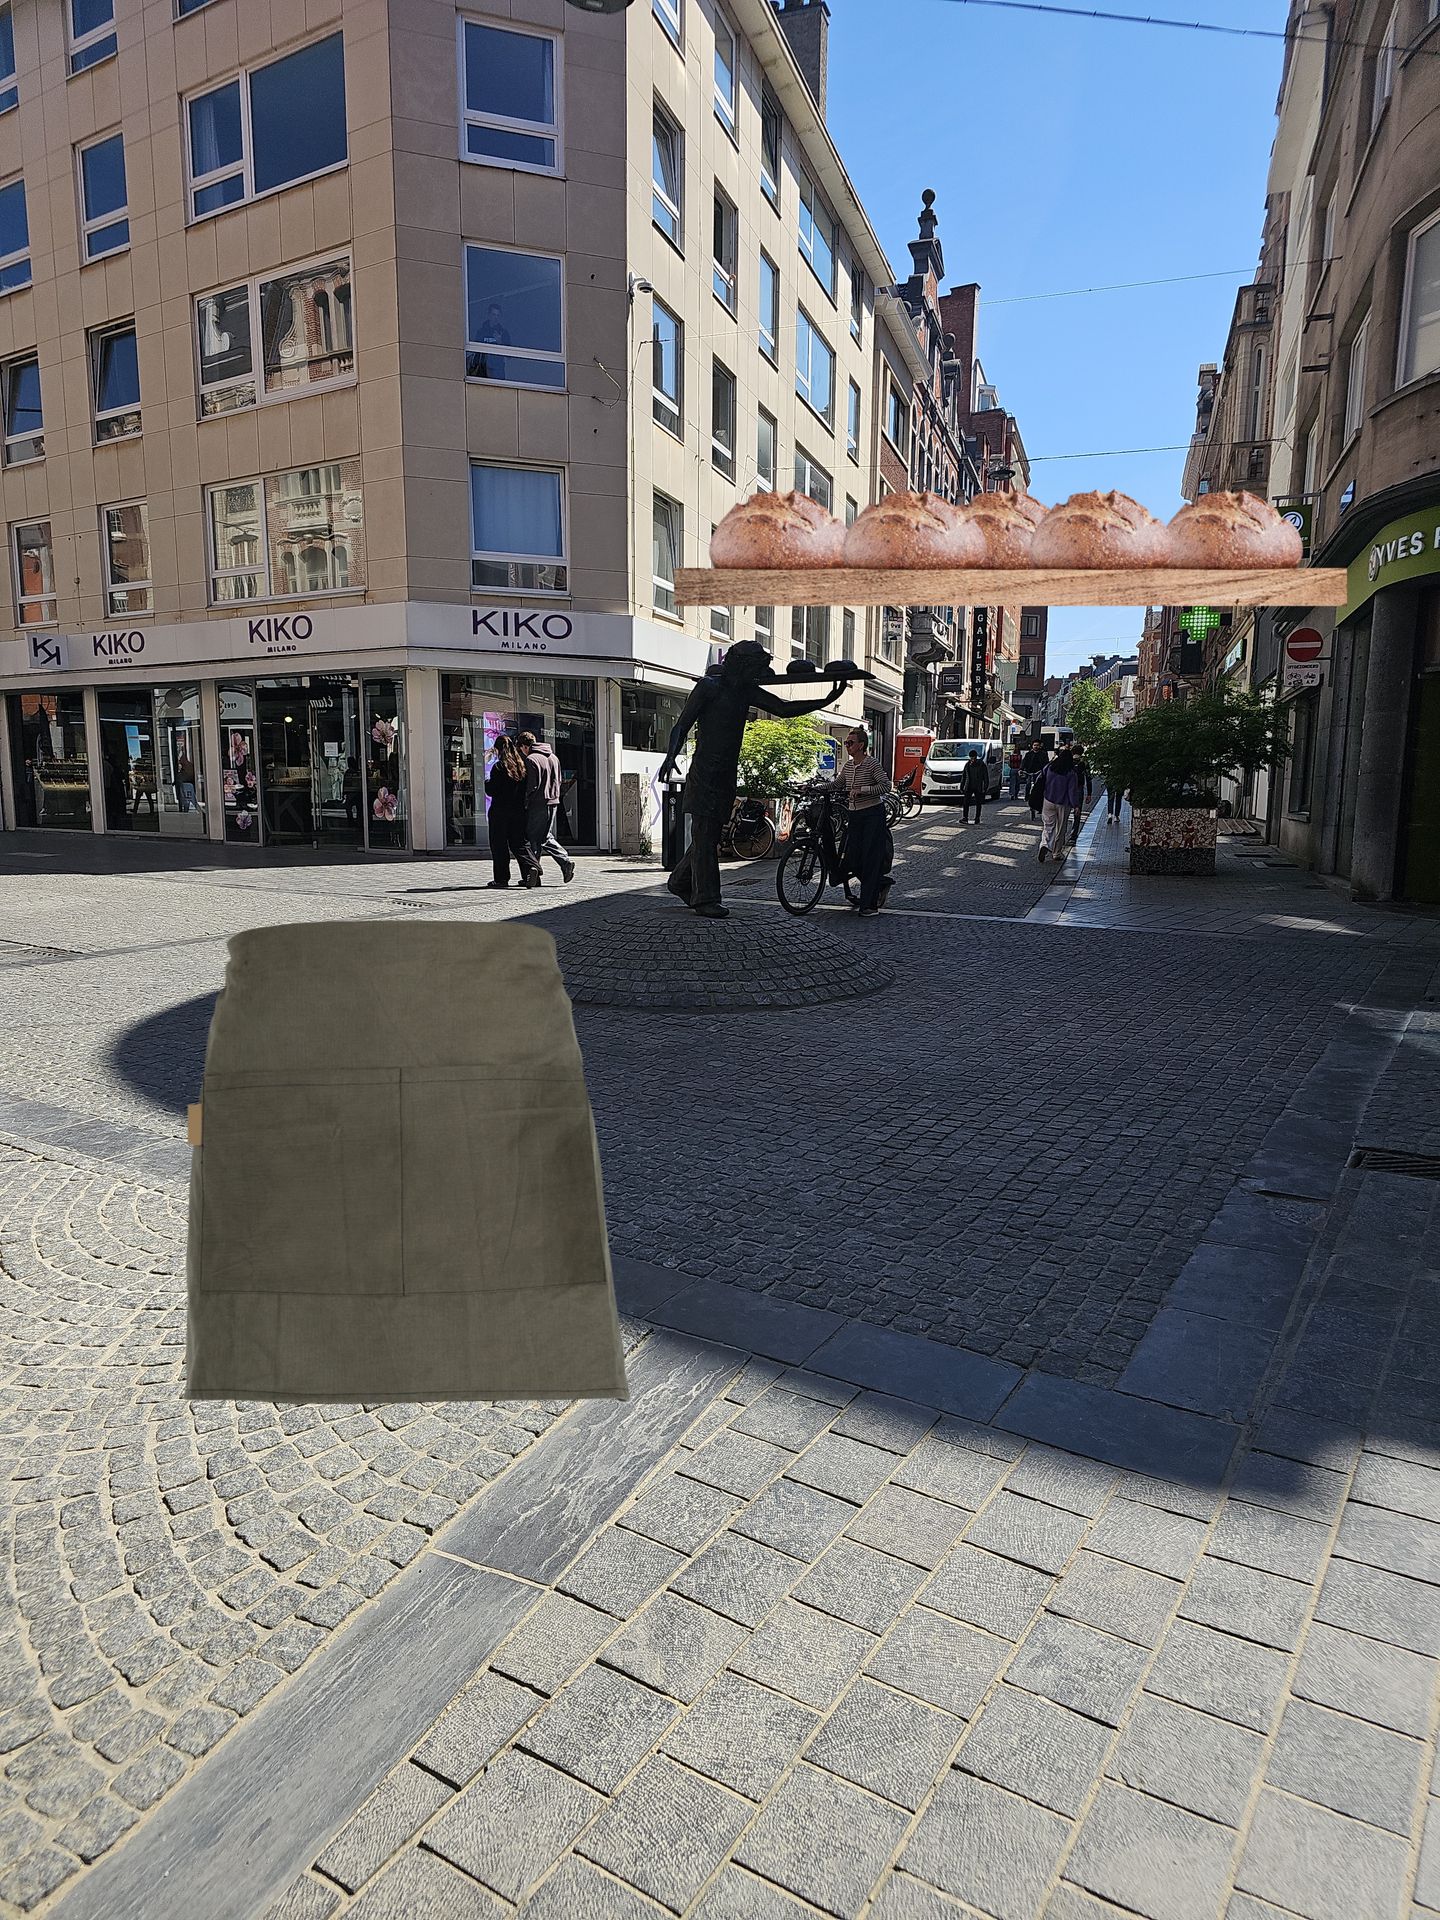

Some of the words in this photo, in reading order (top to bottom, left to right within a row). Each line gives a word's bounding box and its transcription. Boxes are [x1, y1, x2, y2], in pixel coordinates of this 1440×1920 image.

[1376, 531, 1425, 567] YVES
[248, 615, 313, 643] KIKO
[472, 609, 573, 640] KIKO
[92, 631, 145, 657] KIKO
[267, 645, 297, 653] MILANO
[501, 641, 547, 650] MILANO
[974, 613, 984, 696] GALLERY
